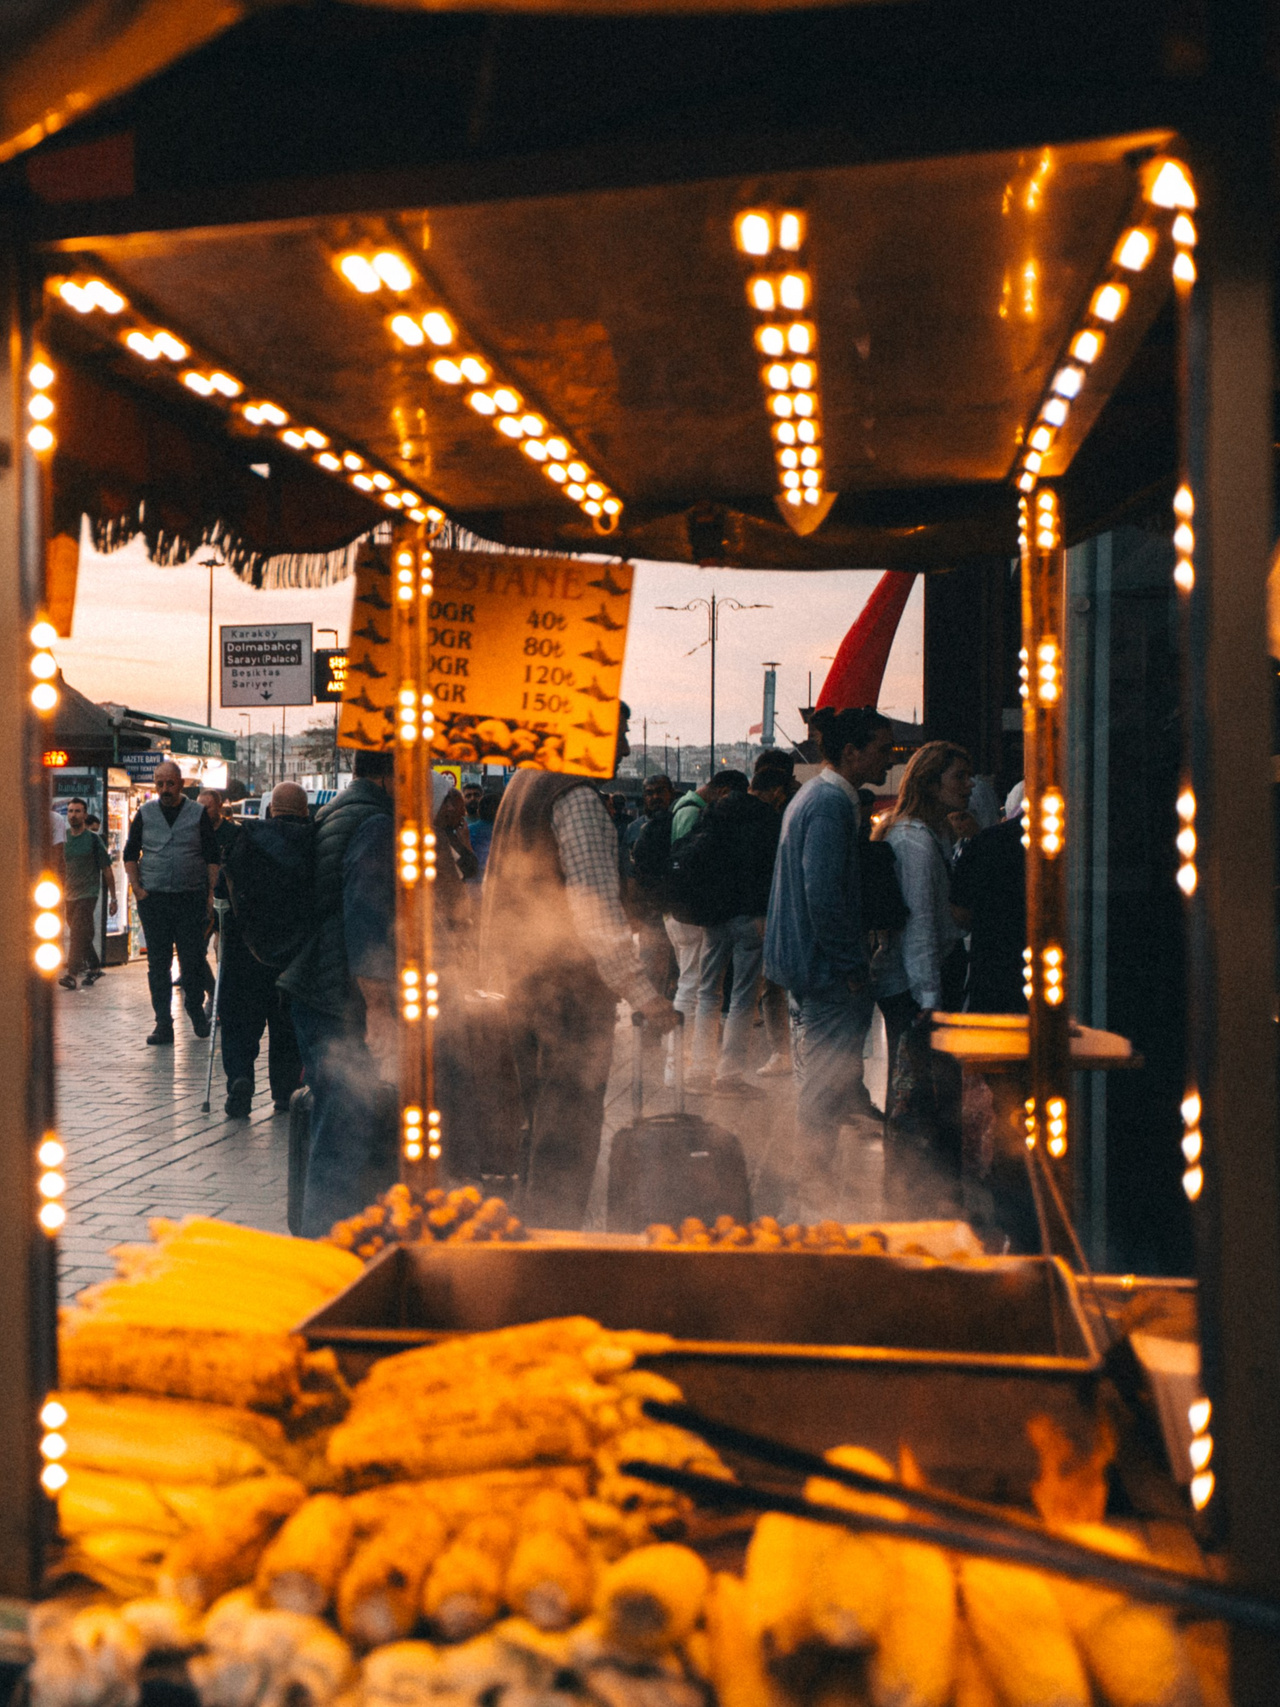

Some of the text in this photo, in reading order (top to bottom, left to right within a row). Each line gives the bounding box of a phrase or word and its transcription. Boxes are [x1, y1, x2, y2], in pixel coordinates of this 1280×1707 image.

[432, 557, 584, 600] ESTANE
[231, 629, 278, 639] Karaköy
[227, 641, 299, 653] Dolmabahçe
[227, 653, 299, 666] Sarayı (Palace)
